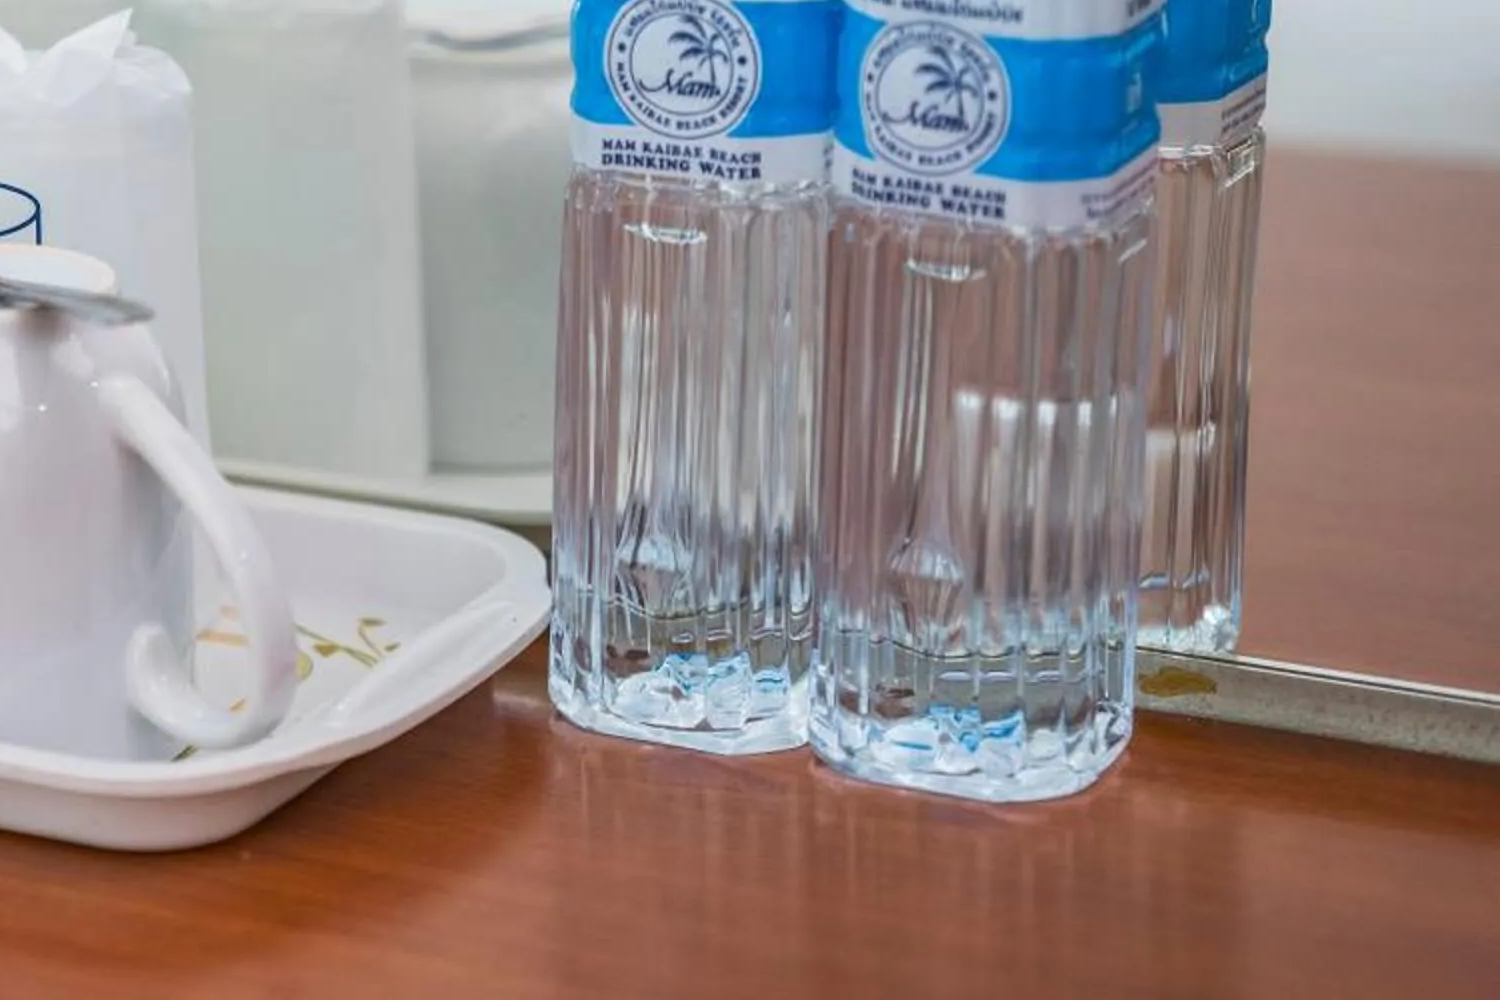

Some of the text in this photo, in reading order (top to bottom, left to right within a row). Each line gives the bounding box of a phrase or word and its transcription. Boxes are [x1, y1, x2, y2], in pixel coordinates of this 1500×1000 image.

[602, 138, 762, 165] MAM KAIBAE BEACH
[602, 152, 761, 180] DRINKING WATER
[883, 176, 943, 194] KAIBAE
[951, 184, 1007, 203] BEACH
[940, 199, 1005, 219] WATER
